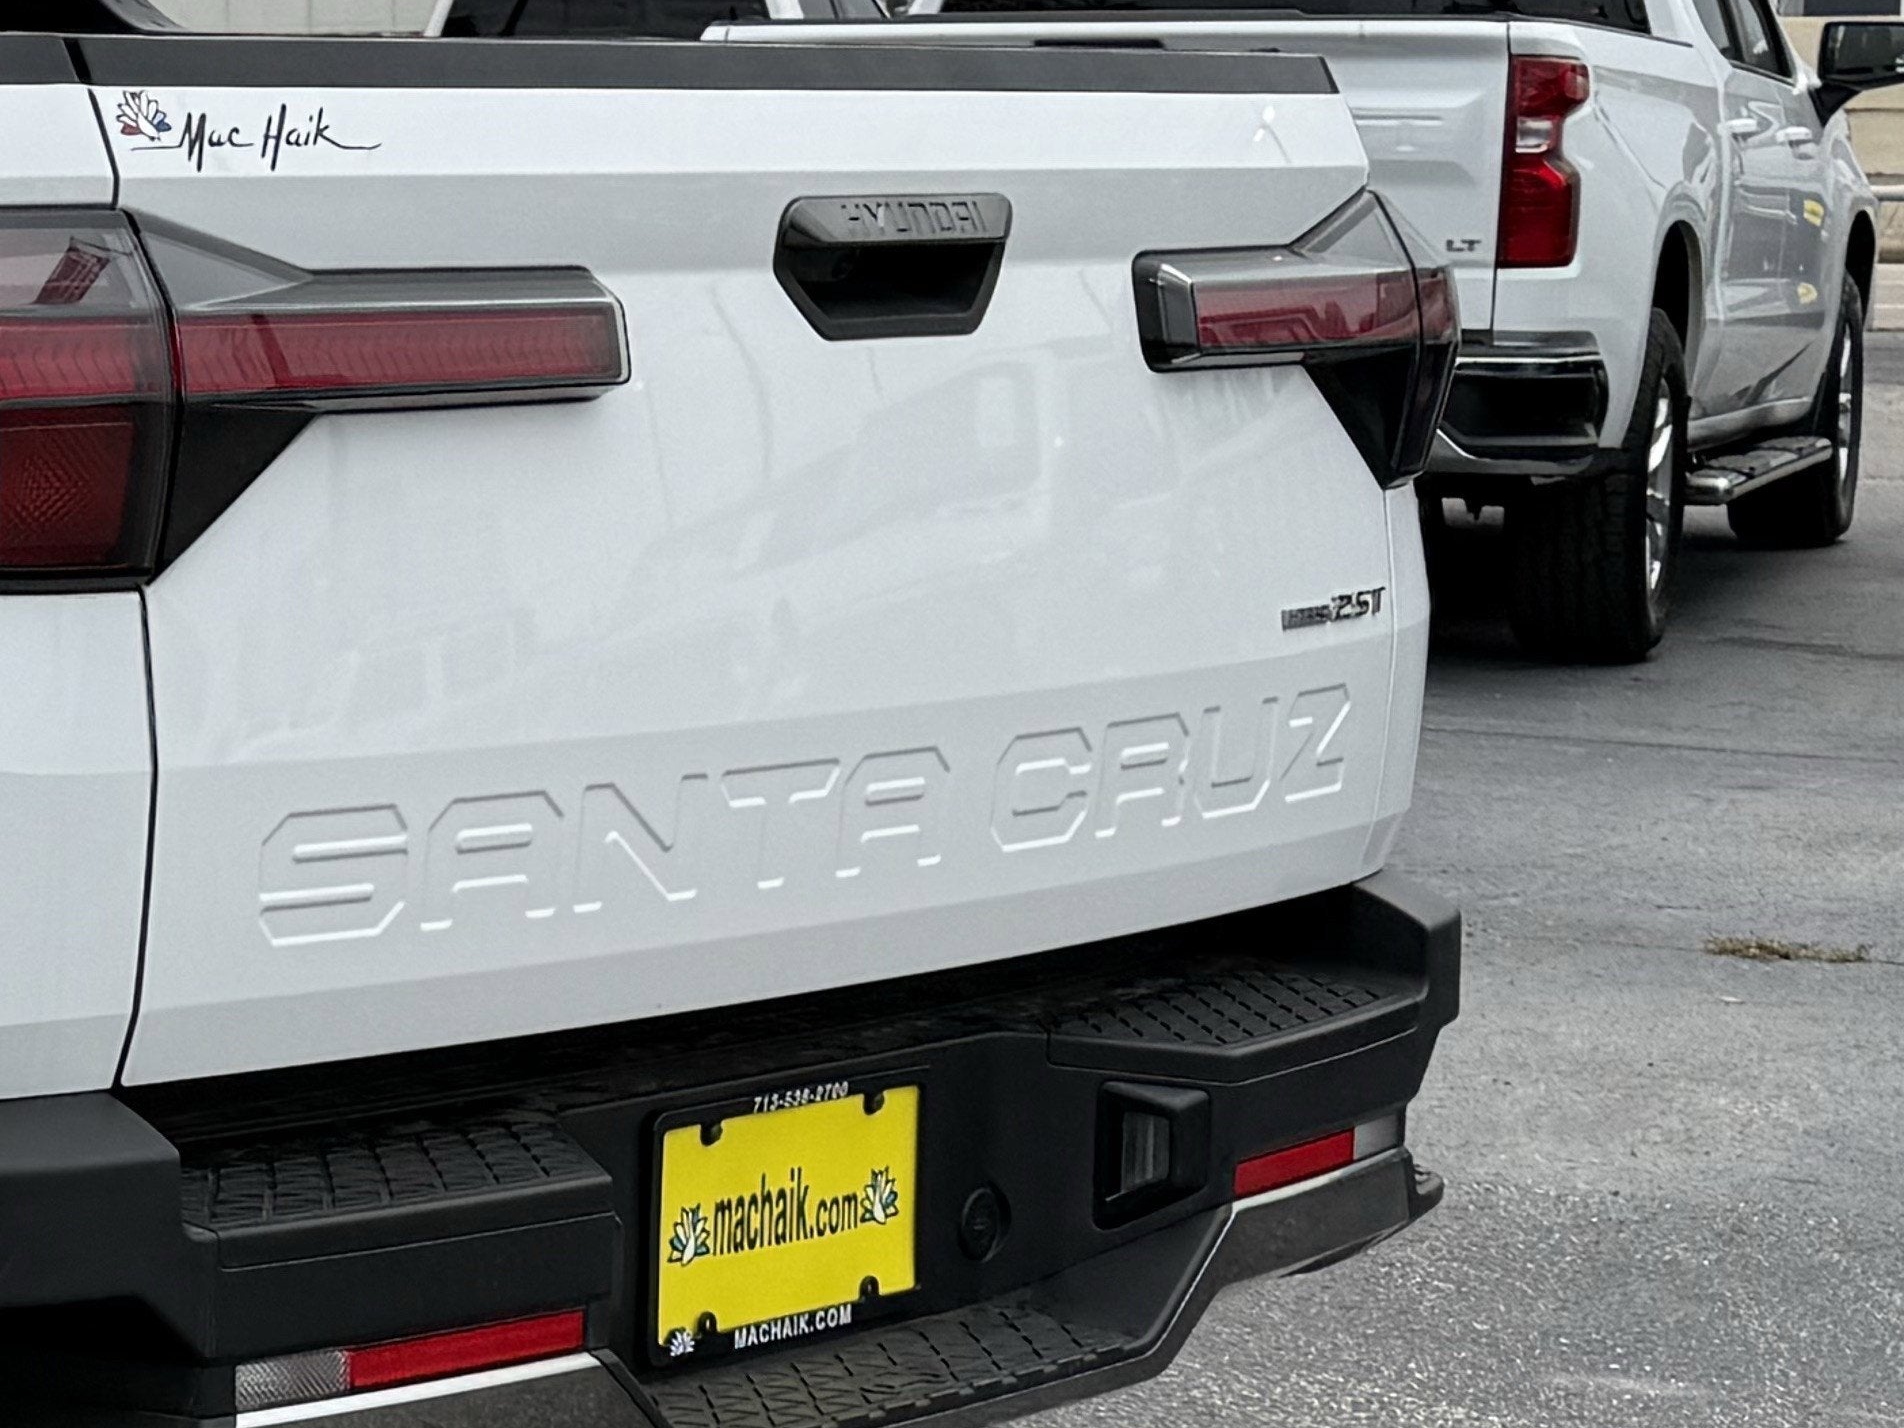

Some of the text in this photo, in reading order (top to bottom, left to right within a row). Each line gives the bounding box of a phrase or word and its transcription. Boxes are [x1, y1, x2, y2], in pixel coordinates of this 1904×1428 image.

[130, 103, 382, 172] Mac Haik
[841, 201, 987, 237] HYUNDAI
[1446, 239, 1482, 252] LT
[258, 683, 1351, 946] SANTA CRUZ
[712, 1166, 858, 1256] machaik.com
[734, 1304, 852, 1349] MACHAIK.COM
